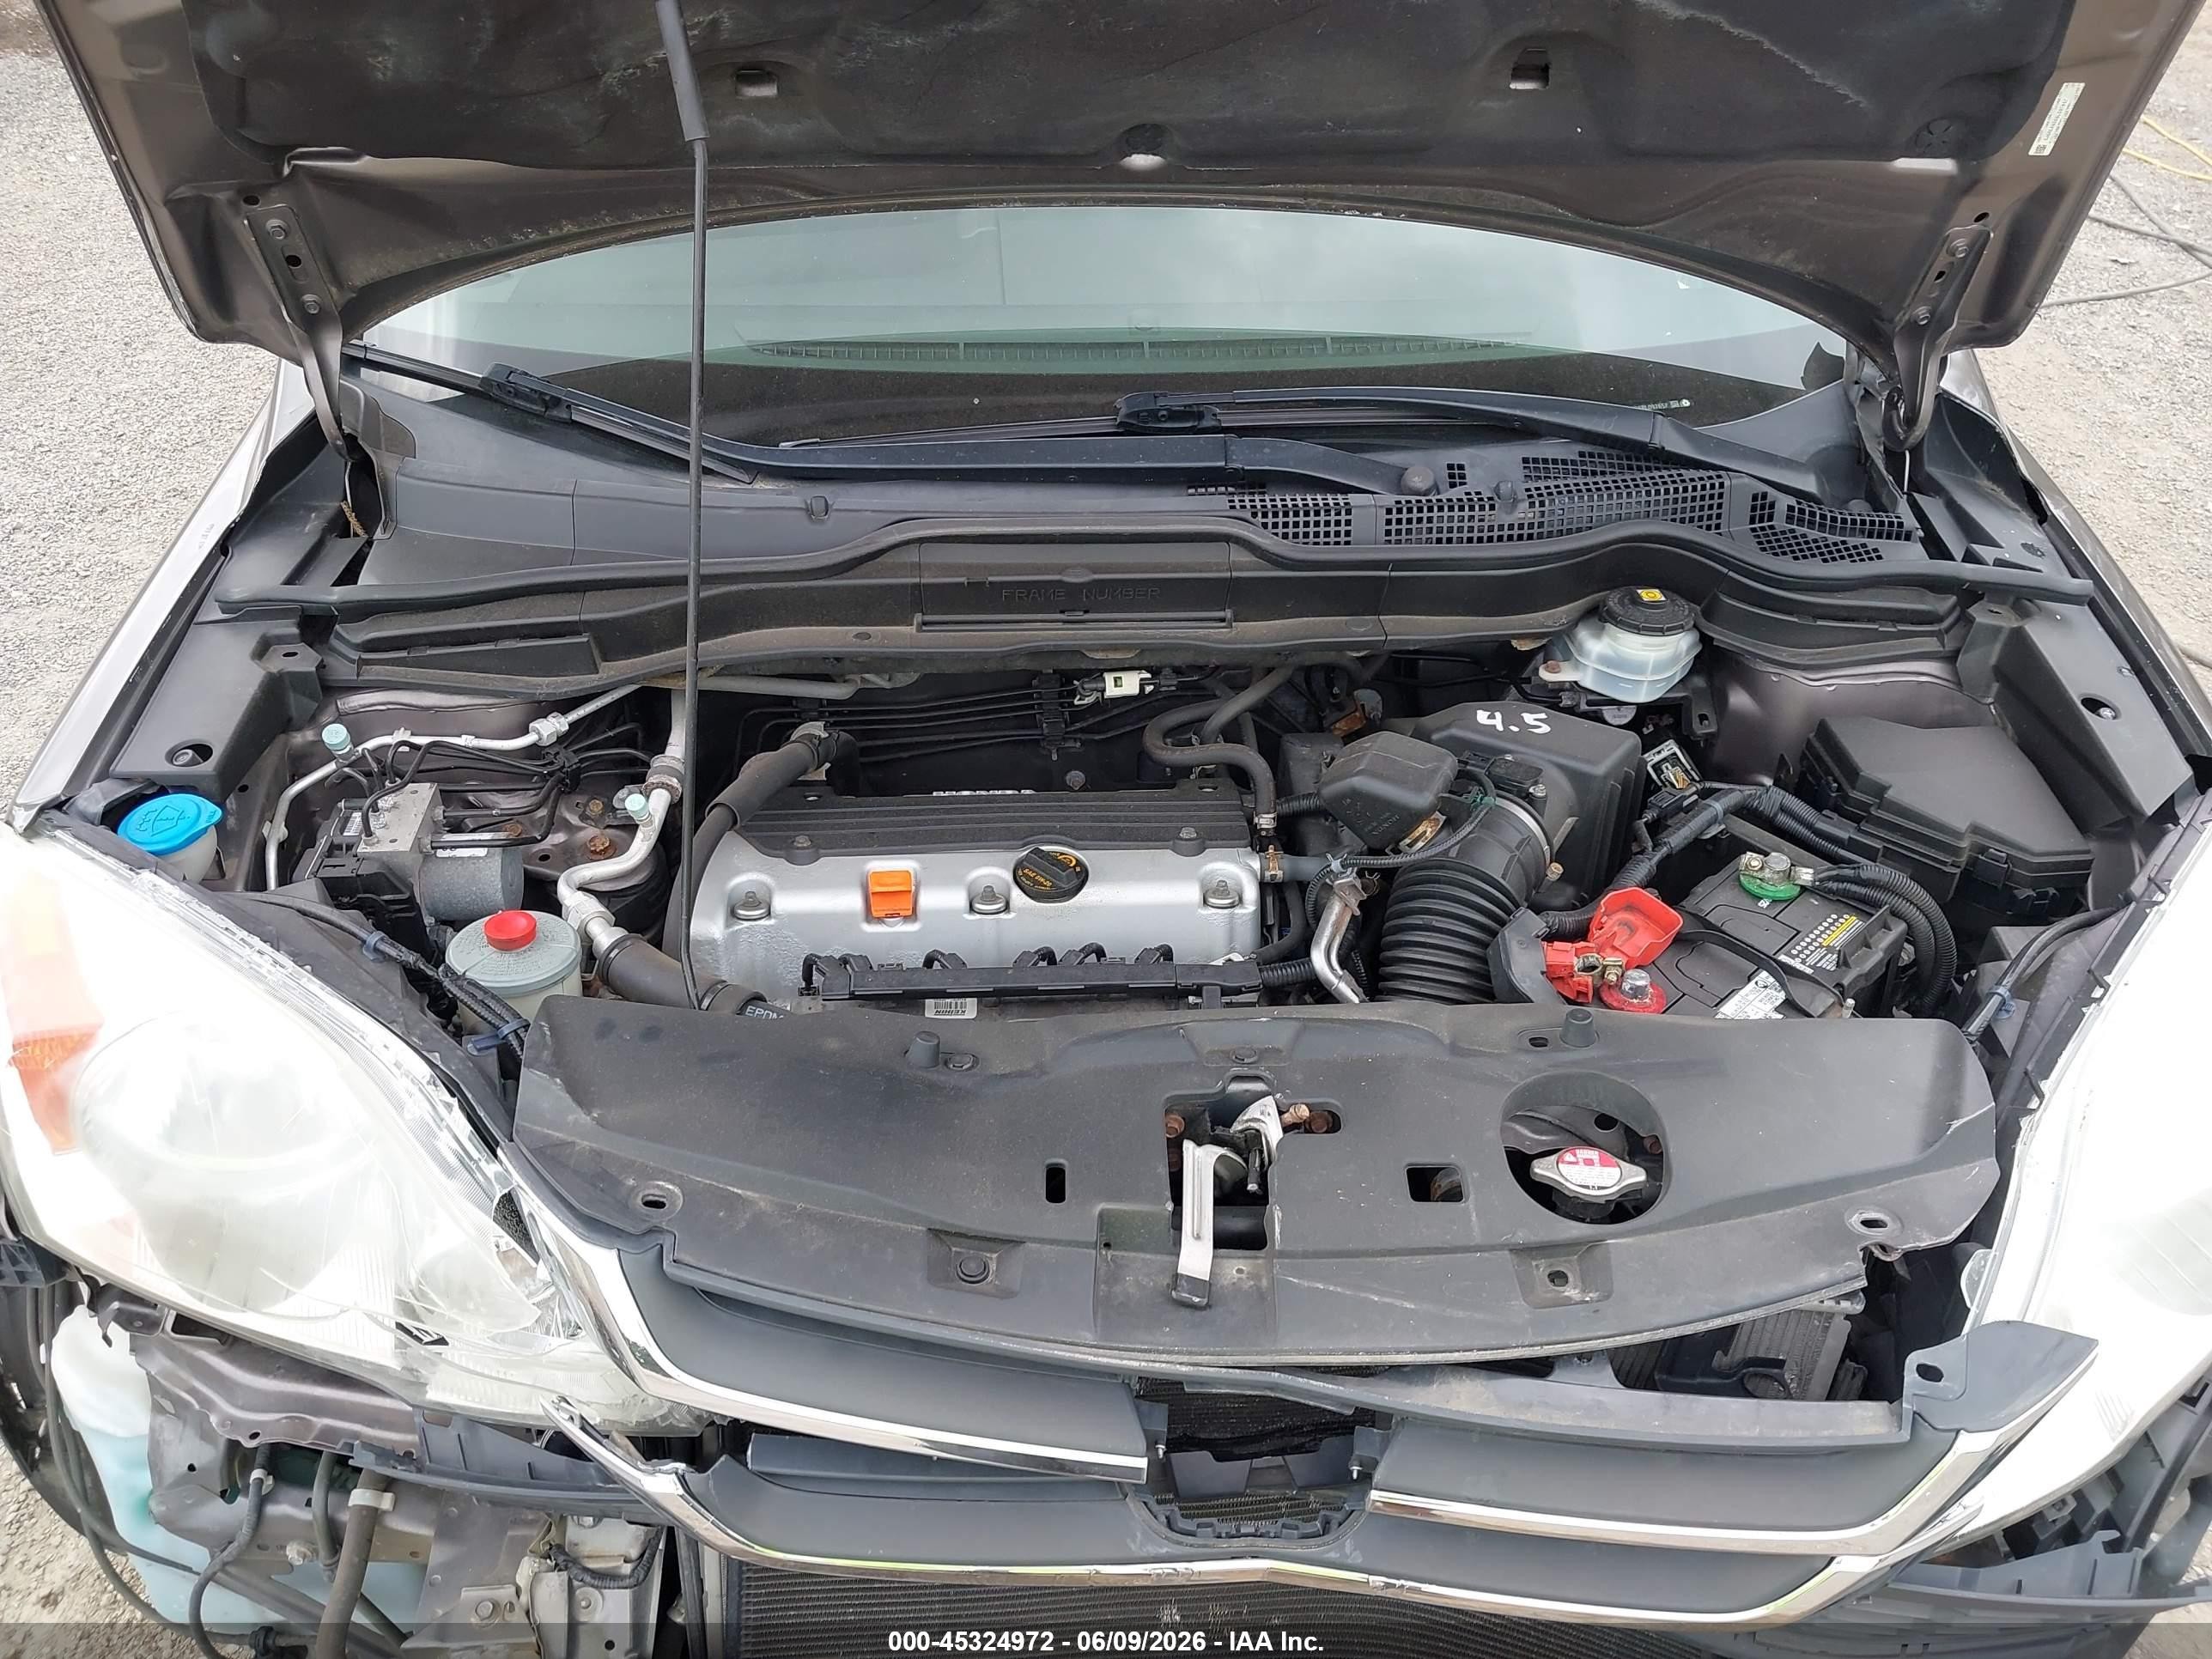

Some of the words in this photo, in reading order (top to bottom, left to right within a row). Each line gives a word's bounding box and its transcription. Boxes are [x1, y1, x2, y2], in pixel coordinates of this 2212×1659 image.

[1002, 588, 1066, 601] FRAME
[1082, 587, 1161, 601] NUMBER
[1476, 709, 1552, 734] 4.5
